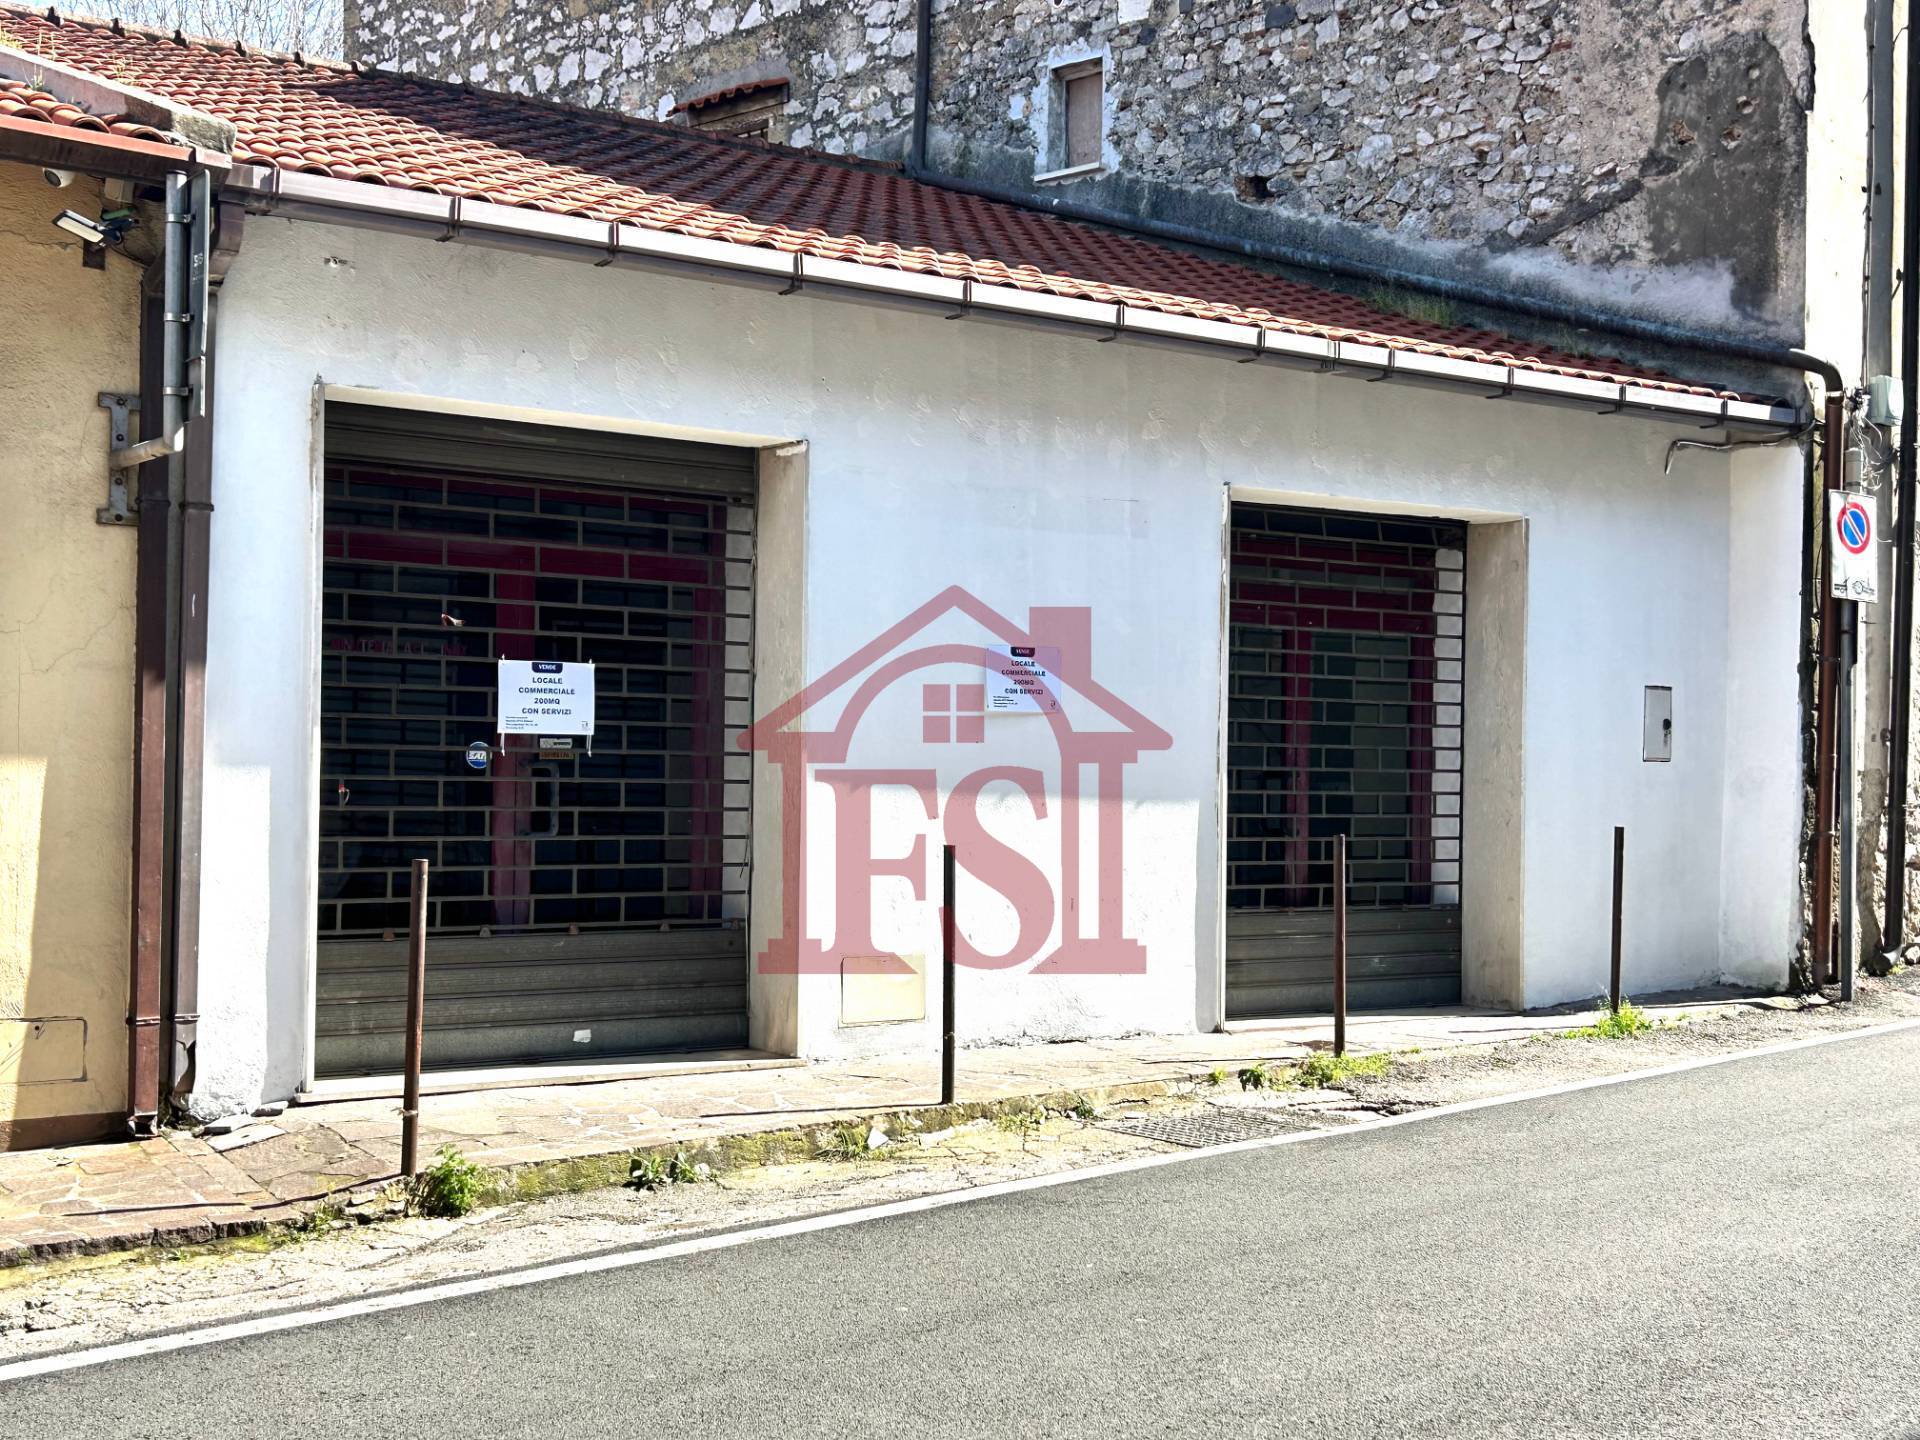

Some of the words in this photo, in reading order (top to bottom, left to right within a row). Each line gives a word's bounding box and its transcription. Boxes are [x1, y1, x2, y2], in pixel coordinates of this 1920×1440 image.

[1001, 669, 1046, 677] COMMERCIALE
[532, 677, 563, 685] LOCALE
[518, 687, 576, 695] COMMERCIALE
[534, 697, 561, 705] 200MQ
[521, 707, 539, 715] CON
[541, 708, 572, 716] SERVIZI
